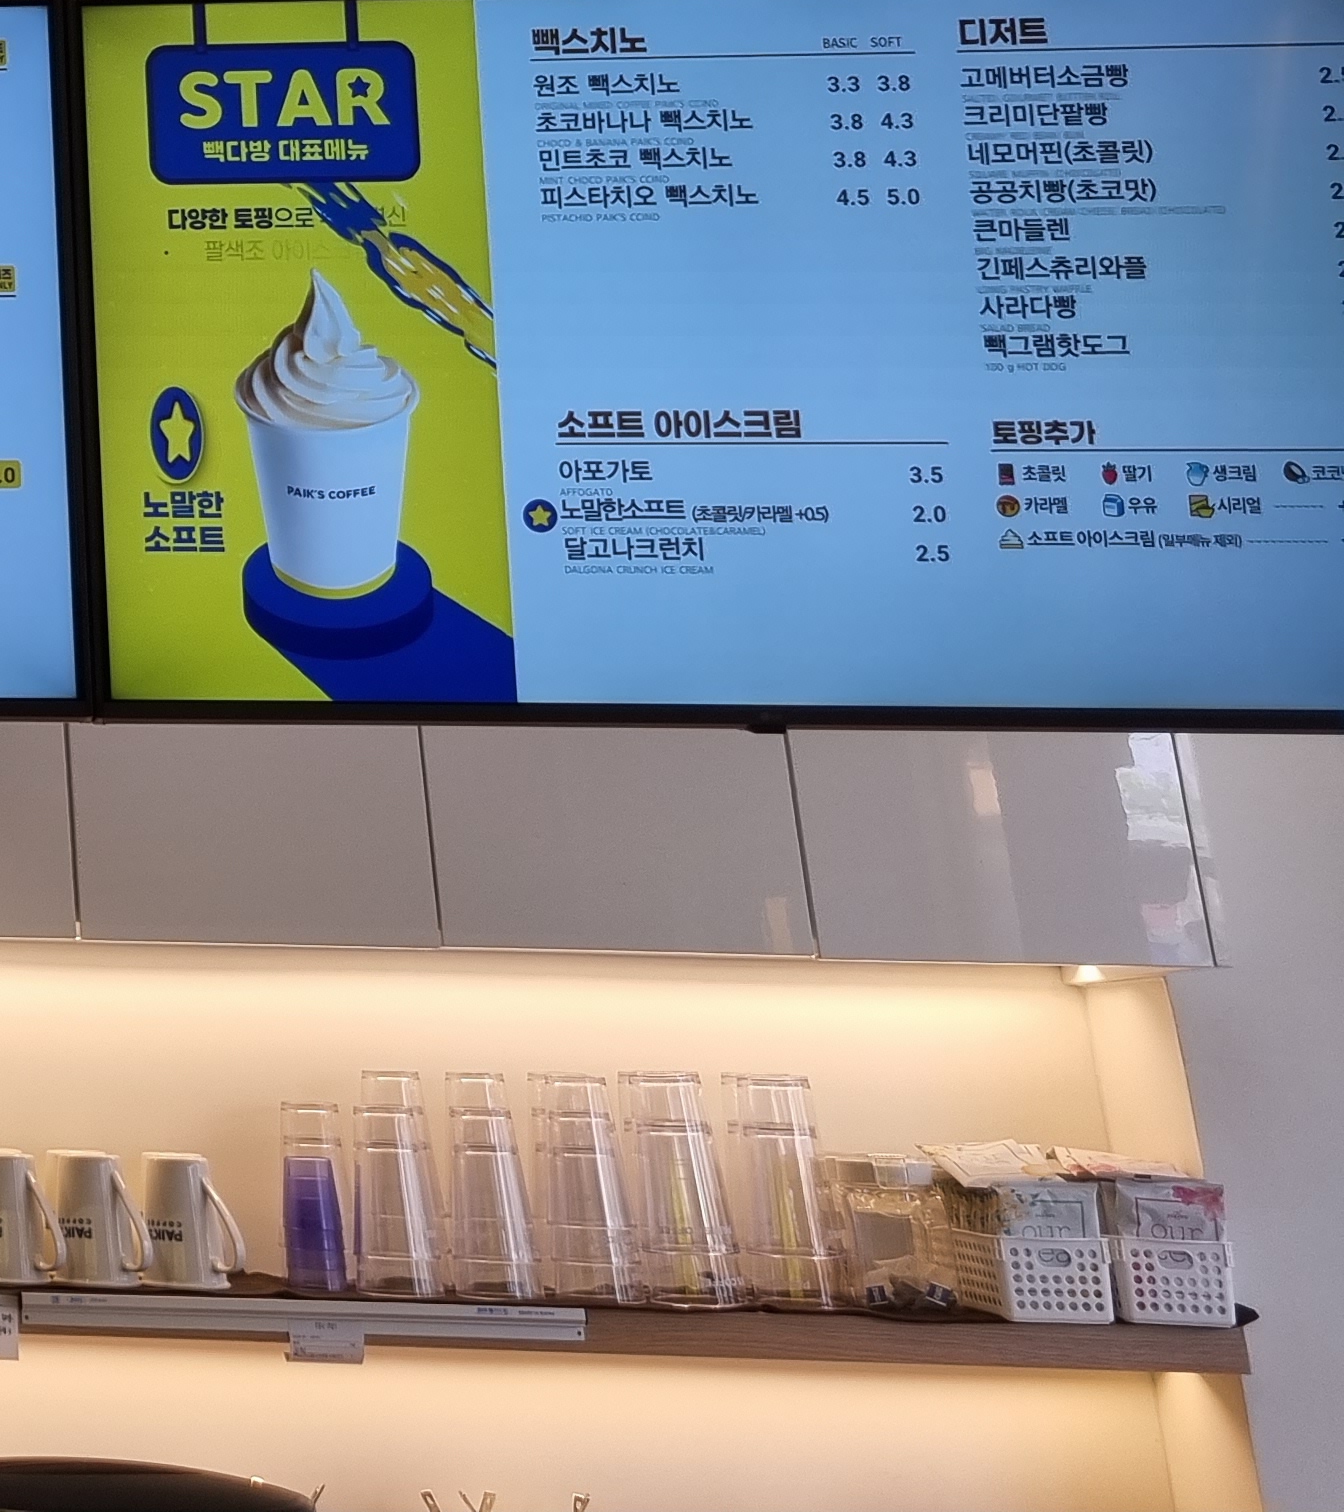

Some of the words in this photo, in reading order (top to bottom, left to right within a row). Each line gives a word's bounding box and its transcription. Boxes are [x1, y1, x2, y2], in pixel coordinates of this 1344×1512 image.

[532, 27, 647, 55] 빽스치노
[823, 37, 857, 49] BASIC
[870, 36, 901, 48] SOFT
[959, 18, 1048, 46] 디저트
[533, 75, 579, 97] 원조
[588, 73, 680, 96] 빽스치노
[827, 76, 860, 92] 3.3
[877, 75, 910, 92] 3.8
[961, 65, 1128, 89] 고메버터소금빵
[179, 69, 390, 129] STAR
[535, 110, 651, 133] 초코바나나
[660, 109, 753, 132] 빽스치노
[963, 104, 1107, 127] 크리미단팥빵
[203, 140, 271, 163] 빽다방
[279, 139, 369, 162] 대표메뉴
[539, 148, 631, 171] 민트초코
[640, 147, 732, 169] 빽스치노
[968, 140, 1153, 165] 네모머핀(초콜릿)
[541, 186, 656, 208] 피스타치오
[665, 184, 758, 207] 빽스치노
[970, 178, 1156, 204] 공공치빵(초코맛)
[168, 208, 228, 230] 다양한
[234, 208, 314, 229] 토핑으로
[973, 218, 1070, 241] 큰마들렌
[977, 256, 1147, 280] 긴페스츄리와플
[980, 295, 1076, 319] 사라다빵
[983, 334, 1131, 358] 빽그램핫도그
[558, 411, 644, 438] 소프트
[654, 410, 801, 438] 아이스크림
[993, 420, 1096, 445] 토핑추가
[559, 459, 652, 483] 아포가토
[1022, 465, 1066, 482] 초콜릿
[1122, 465, 1152, 483] 딸기
[1213, 464, 1257, 482] 생크림
[143, 491, 224, 518] 노말한
[287, 485, 325, 499] PAIK'S
[329, 485, 376, 500] COFFEE
[560, 498, 686, 522] 노말한소프트
[1024, 497, 1068, 514] 카라멜
[1128, 498, 1157, 513] 우유
[1218, 497, 1261, 515] 시리얼
[145, 527, 225, 552] 소프트
[564, 537, 704, 561] 달고나크런치
[916, 545, 949, 562] 2.5
[1028, 531, 1075, 546] 소프트
[1078, 531, 1154, 547] 아이스크림
